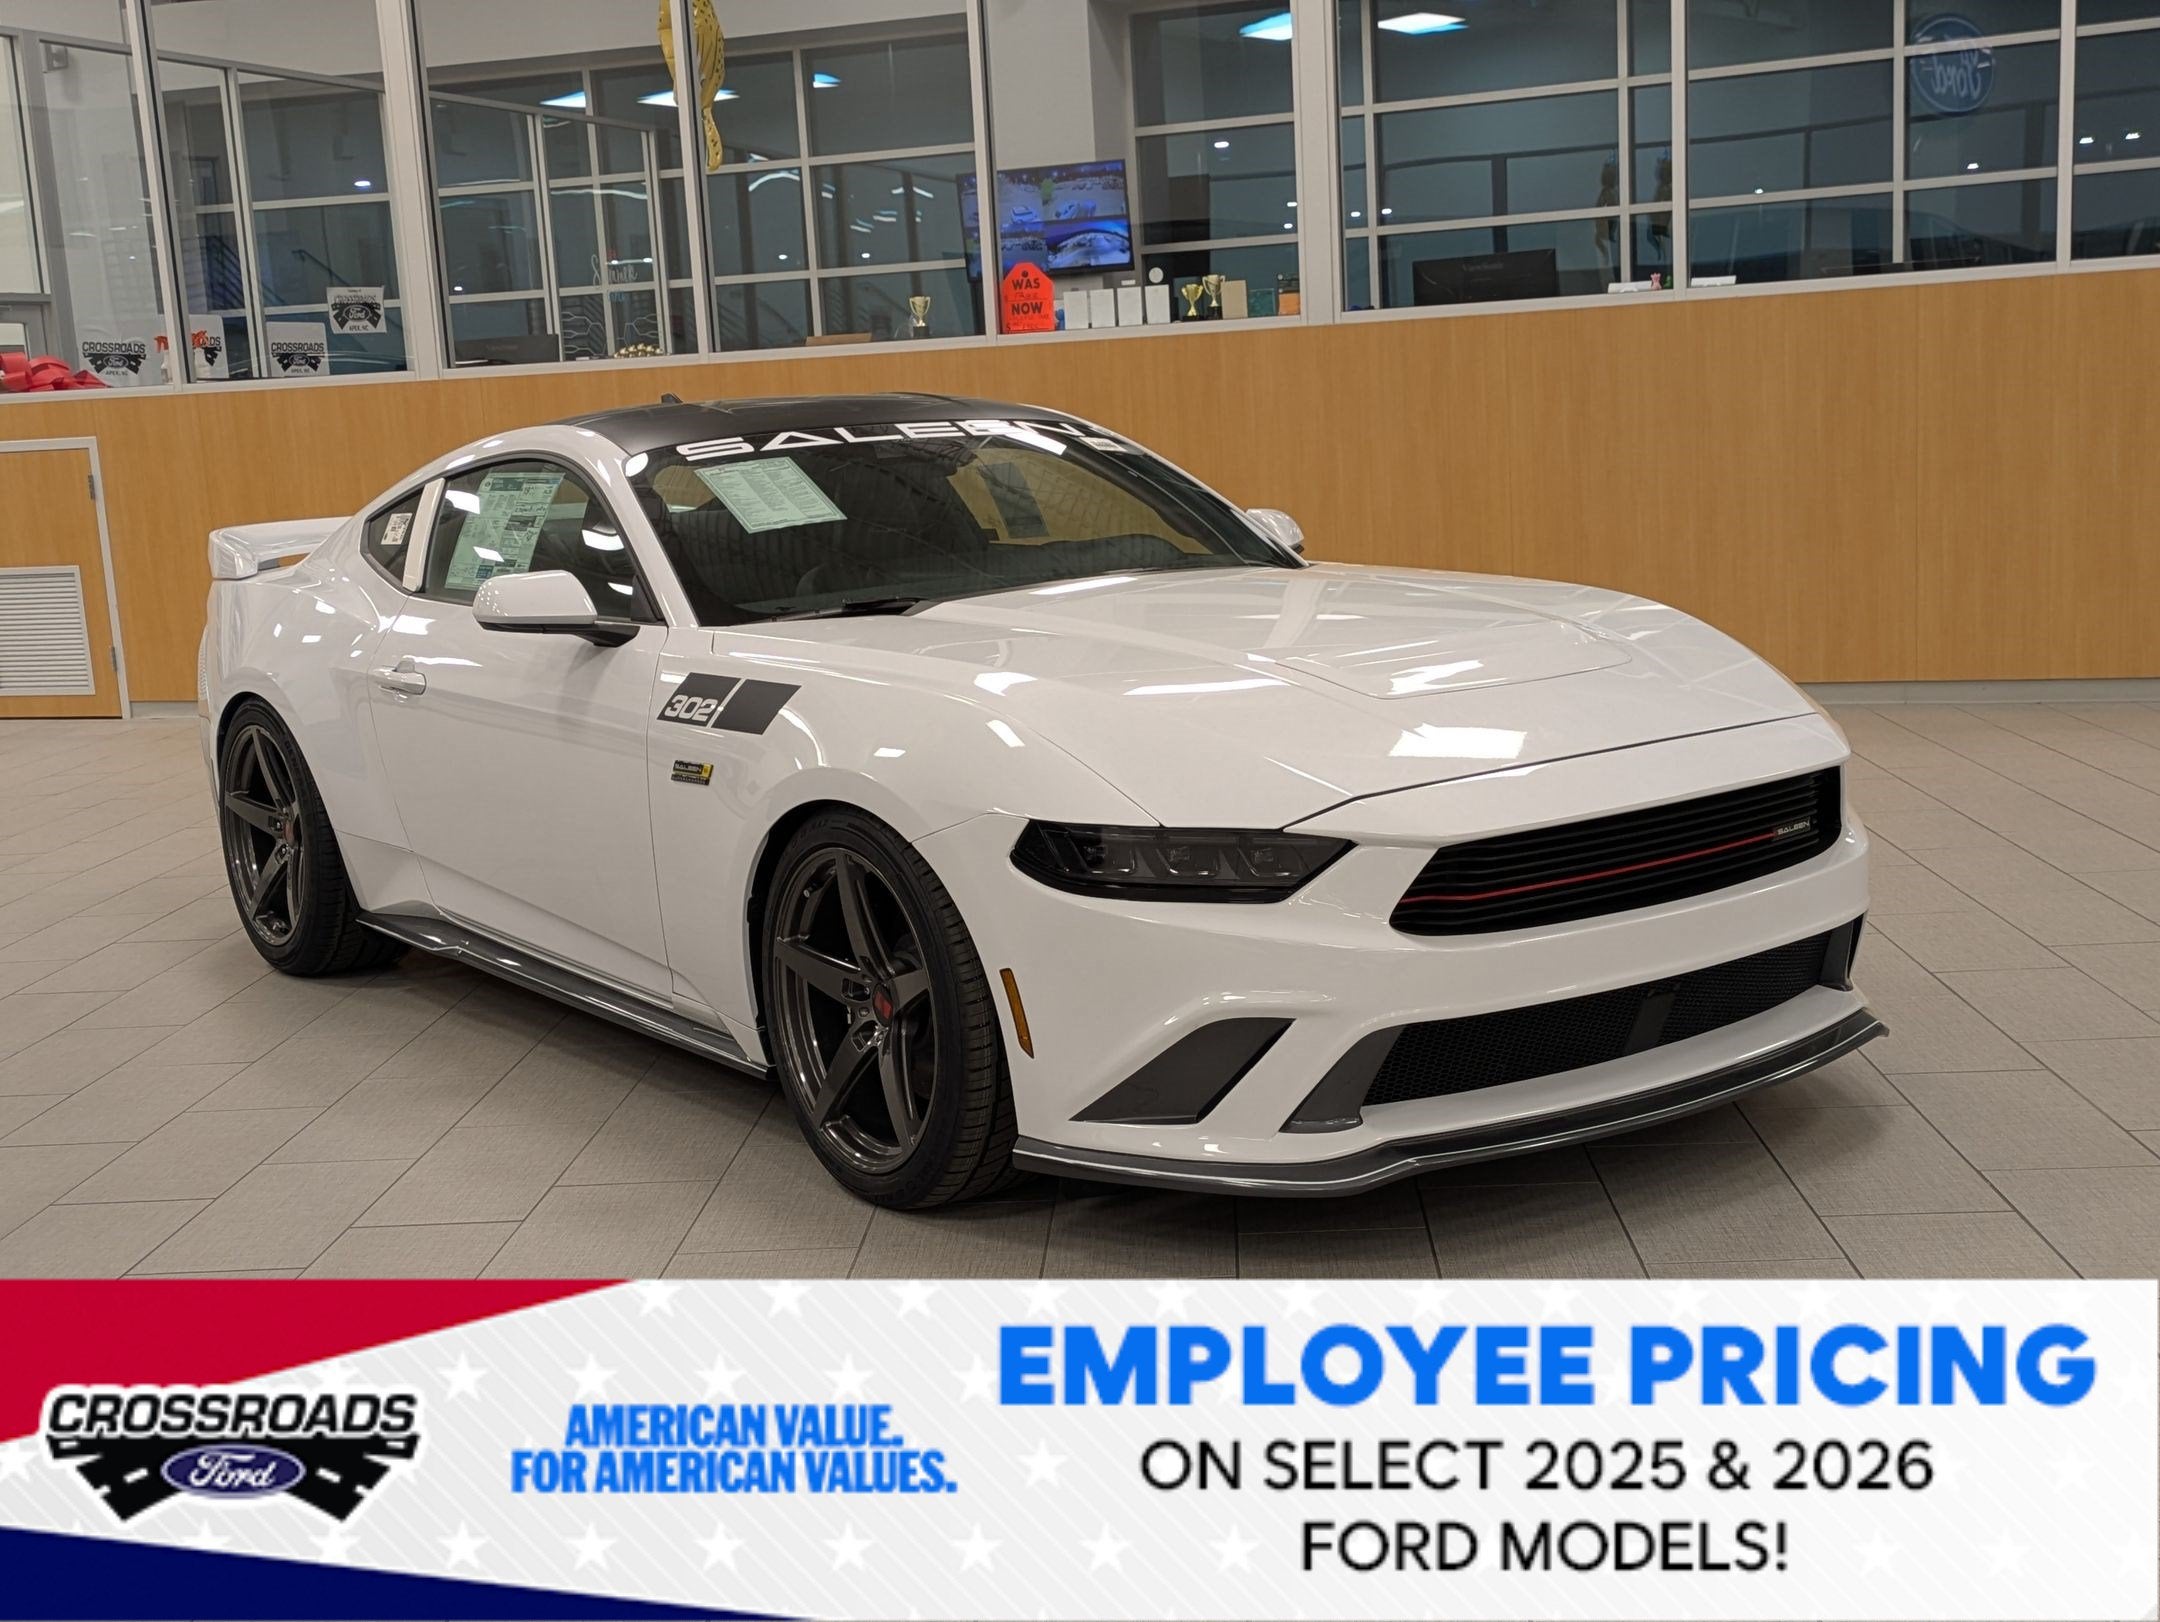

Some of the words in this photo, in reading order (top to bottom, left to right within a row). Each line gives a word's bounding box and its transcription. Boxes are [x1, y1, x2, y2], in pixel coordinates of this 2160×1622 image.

[1012, 278, 1041, 290] WAS
[1012, 301, 1043, 315] NOW
[82, 341, 146, 354] CROSSROADS
[271, 342, 324, 352] CROSSROADS
[676, 420, 1086, 462] SALEEN
[664, 694, 718, 722] 302
[1777, 820, 1810, 835] SALEEN
